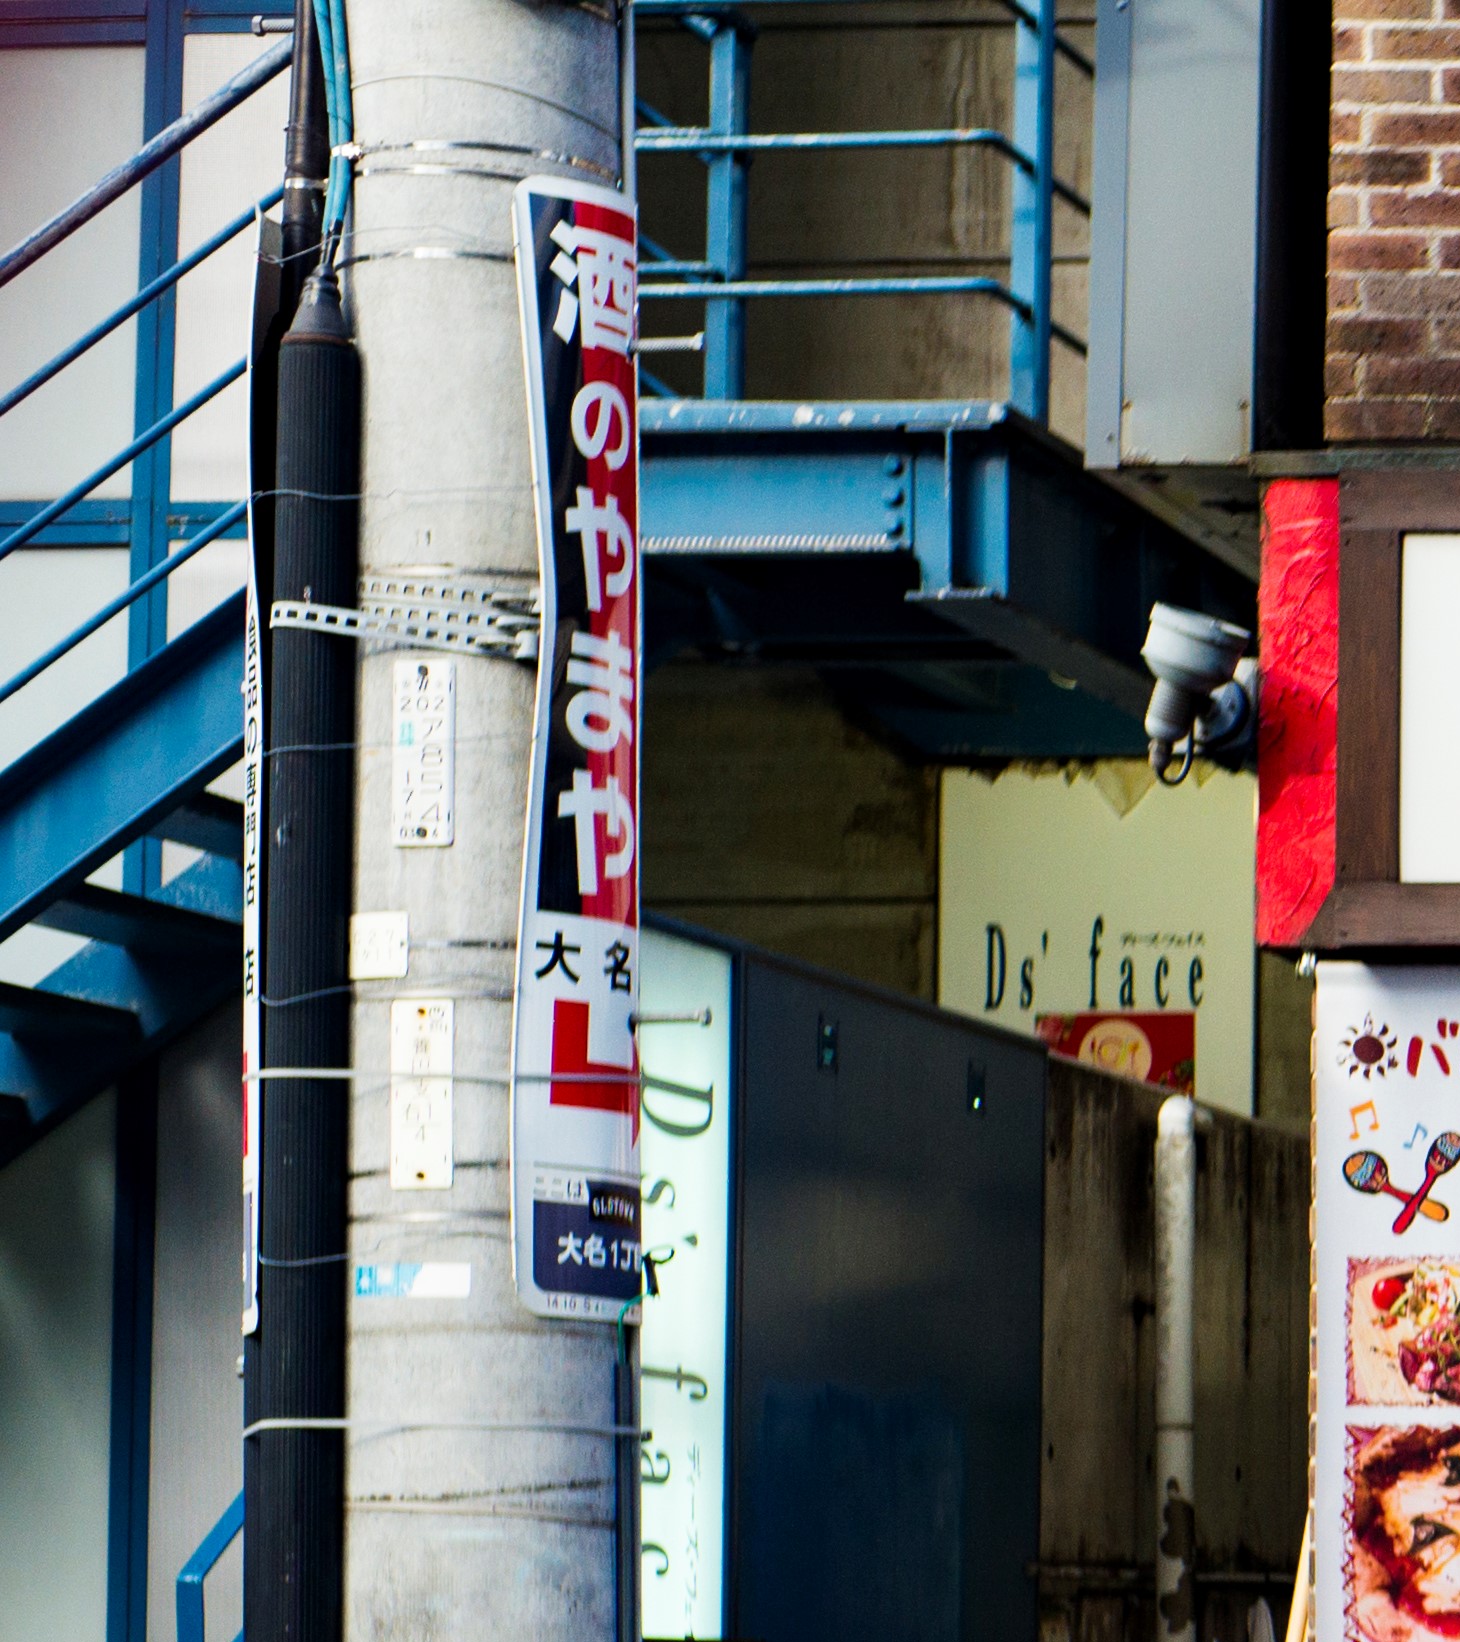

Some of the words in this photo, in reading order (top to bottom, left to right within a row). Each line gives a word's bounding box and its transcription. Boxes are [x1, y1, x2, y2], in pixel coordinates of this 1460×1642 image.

[549, 219, 637, 897] 酒のやまや
[984, 922, 1049, 1013] Ds'
[1088, 913, 1205, 1012] face
[641, 1363, 709, 1578] fac
